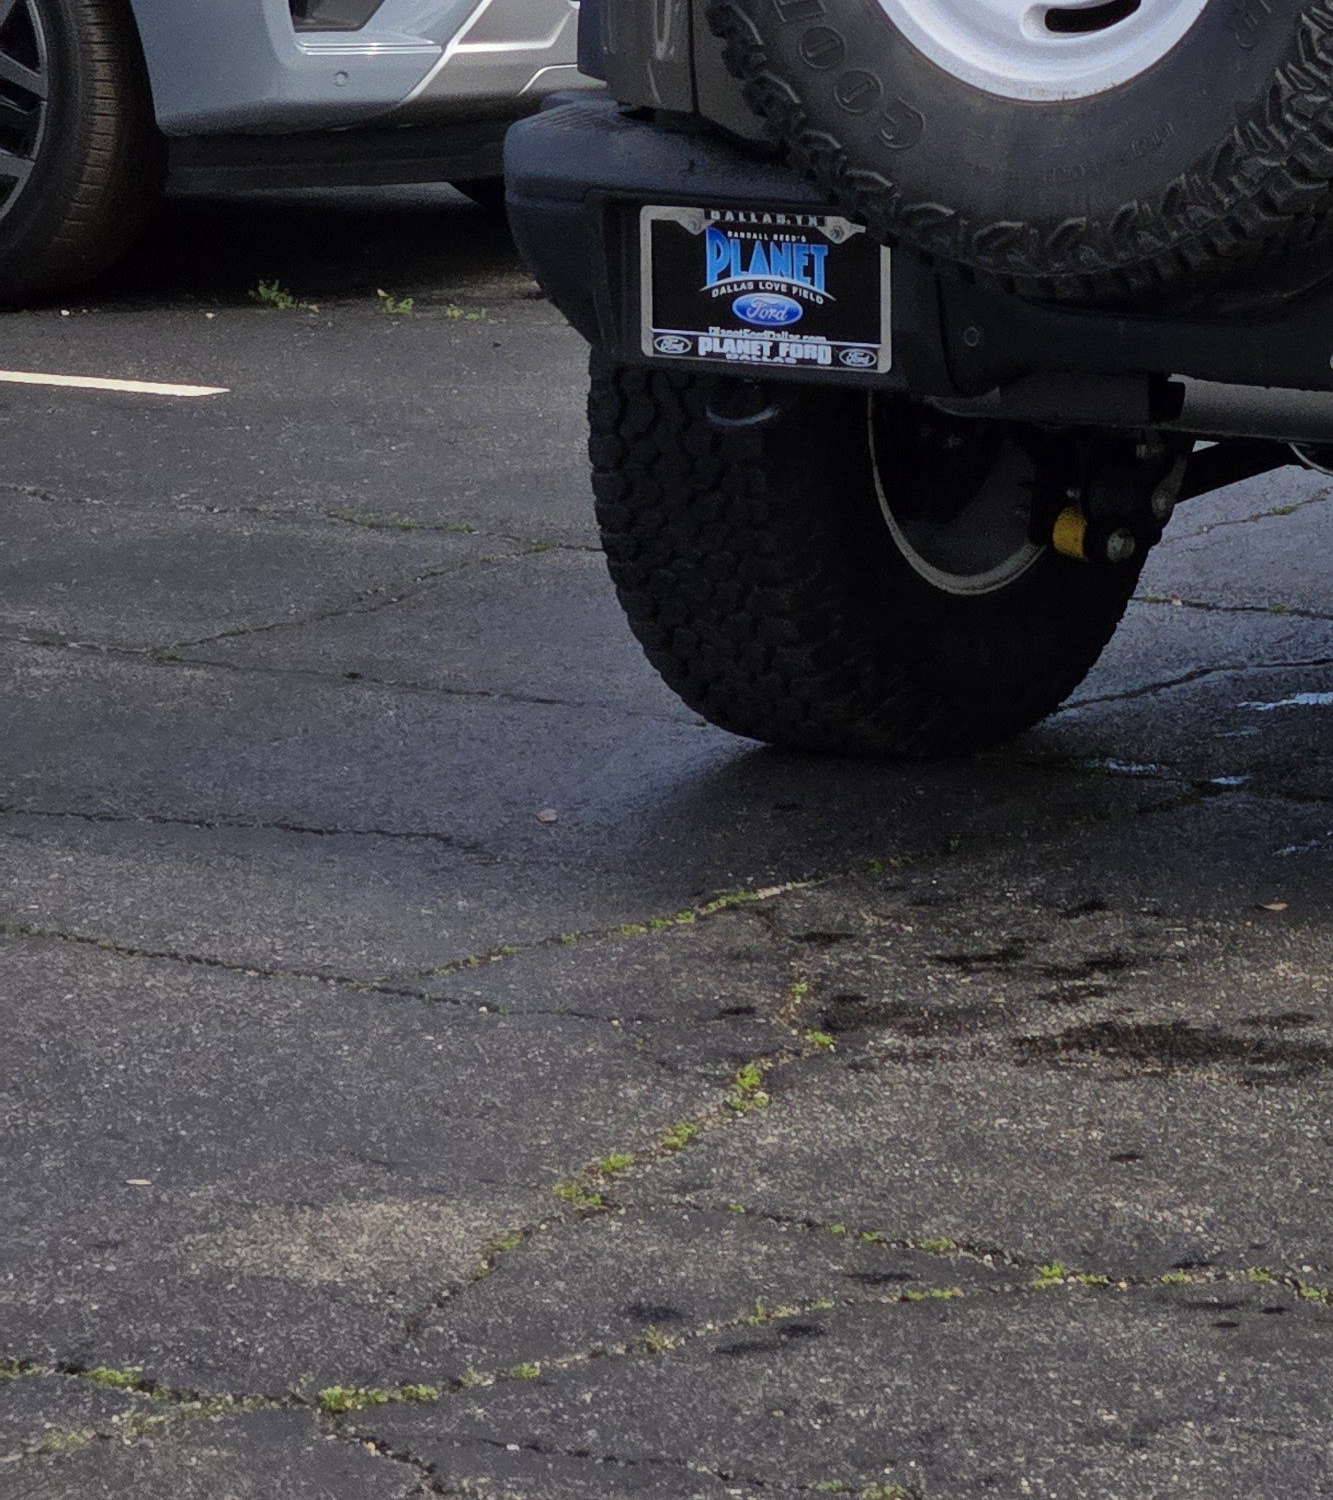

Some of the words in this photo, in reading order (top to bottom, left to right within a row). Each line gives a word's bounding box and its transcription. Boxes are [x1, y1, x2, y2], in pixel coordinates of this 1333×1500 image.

[705, 226, 829, 293] PLANET
[711, 281, 754, 298] DALLAS
[758, 281, 788, 293] LOVE
[792, 285, 824, 305] FIELD
[746, 298, 789, 321] Ford
[698, 336, 773, 356] PLANET
[778, 341, 832, 365] FORD
